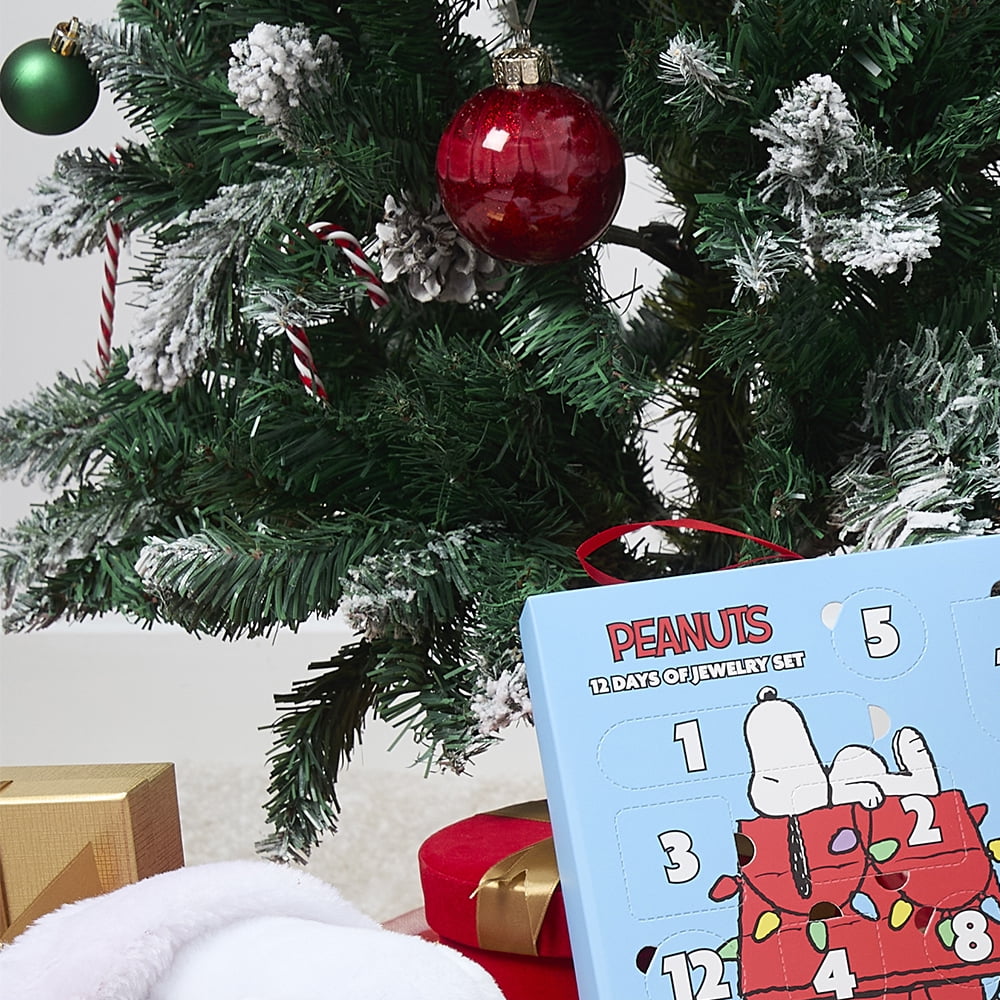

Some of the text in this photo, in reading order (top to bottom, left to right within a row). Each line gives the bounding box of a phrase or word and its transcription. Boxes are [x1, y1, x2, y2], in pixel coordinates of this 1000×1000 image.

[606, 604, 773, 662] PEANUTS
[861, 605, 900, 659] 5
[588, 651, 806, 695] 12 DAYS OF JEWELRY SET
[673, 719, 707, 773] 1
[900, 793, 943, 847] 2
[657, 829, 701, 884] 3
[951, 909, 993, 963] 8
[812, 947, 858, 1000] 4
